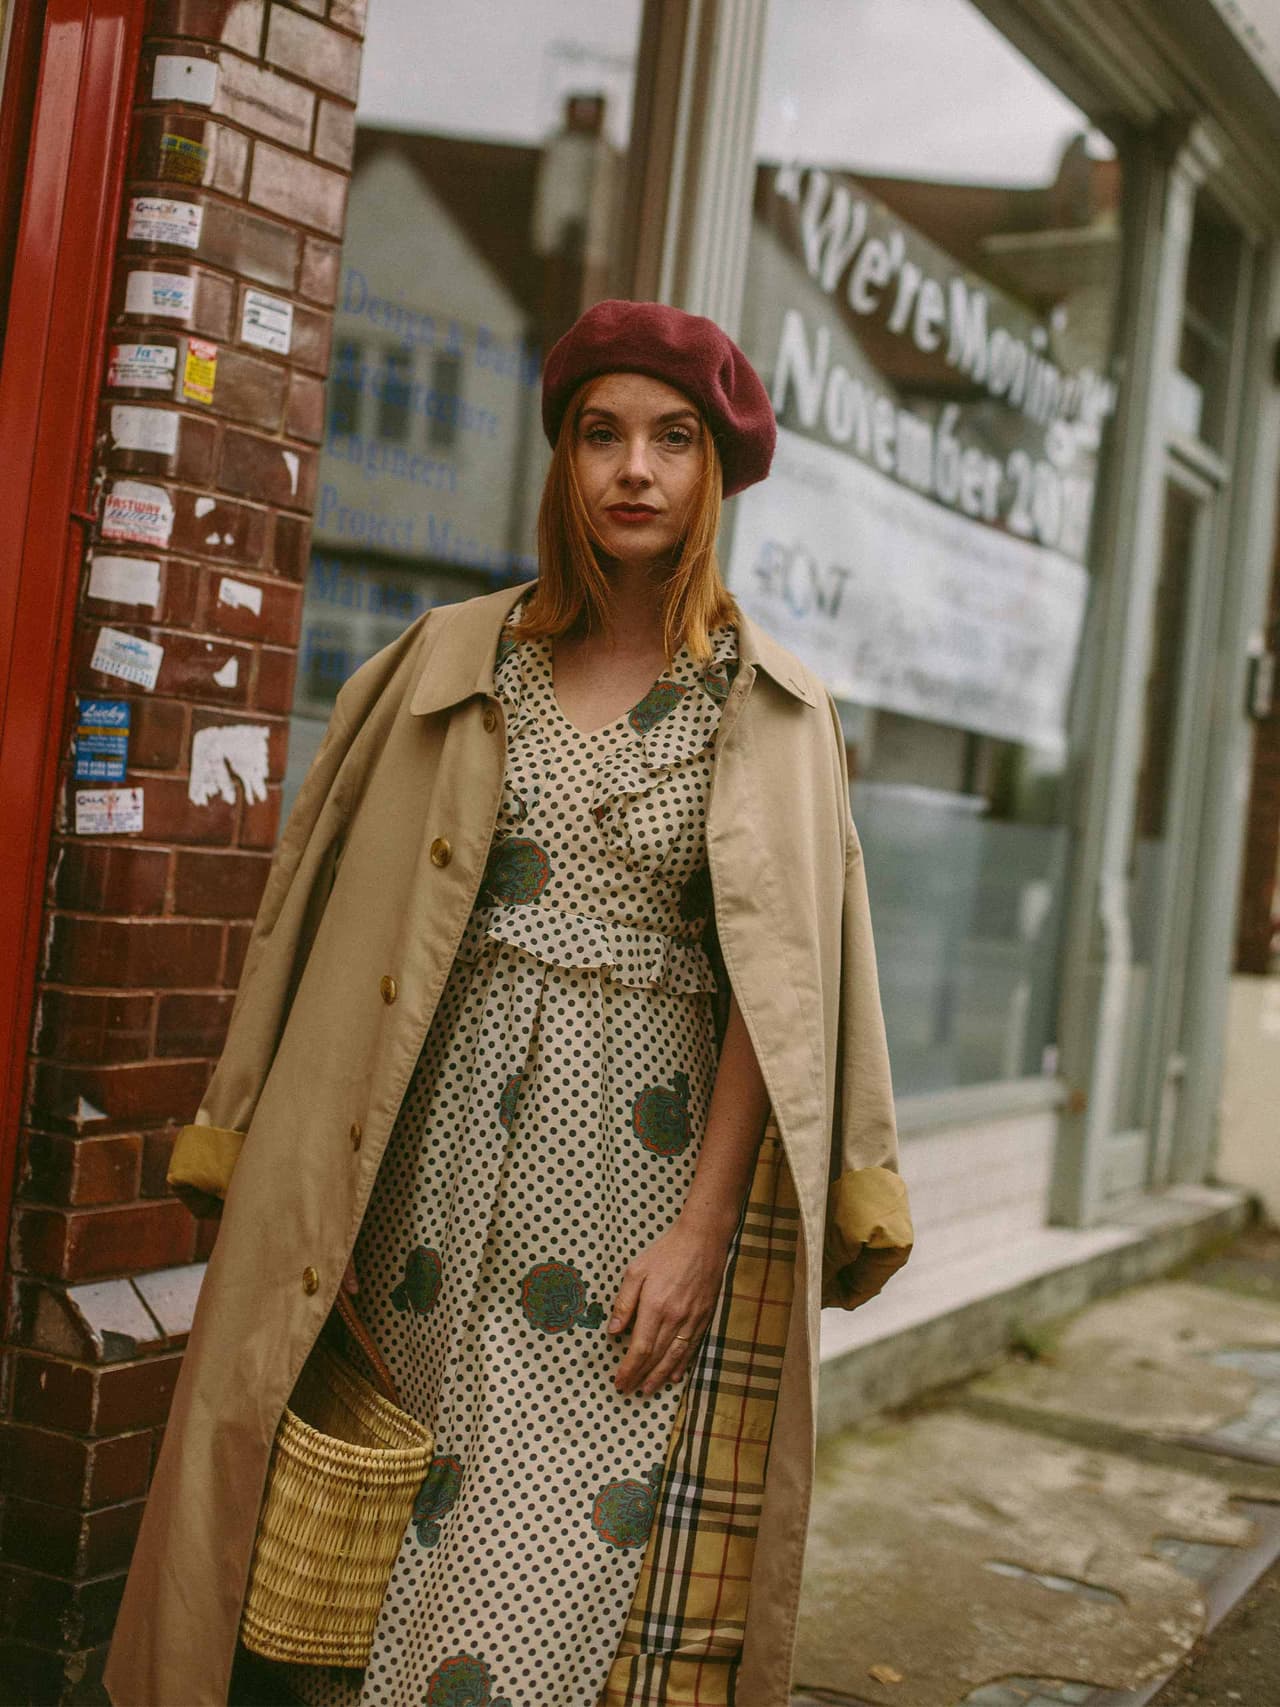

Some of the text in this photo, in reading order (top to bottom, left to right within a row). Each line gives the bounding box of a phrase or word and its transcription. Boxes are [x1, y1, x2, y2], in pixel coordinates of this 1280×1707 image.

[342, 266, 435, 352] Design
[332, 342, 498, 434] Architecture
[773, 308, 1095, 552] November 20
[316, 482, 417, 552] Project
[82, 703, 126, 726] Lucky
